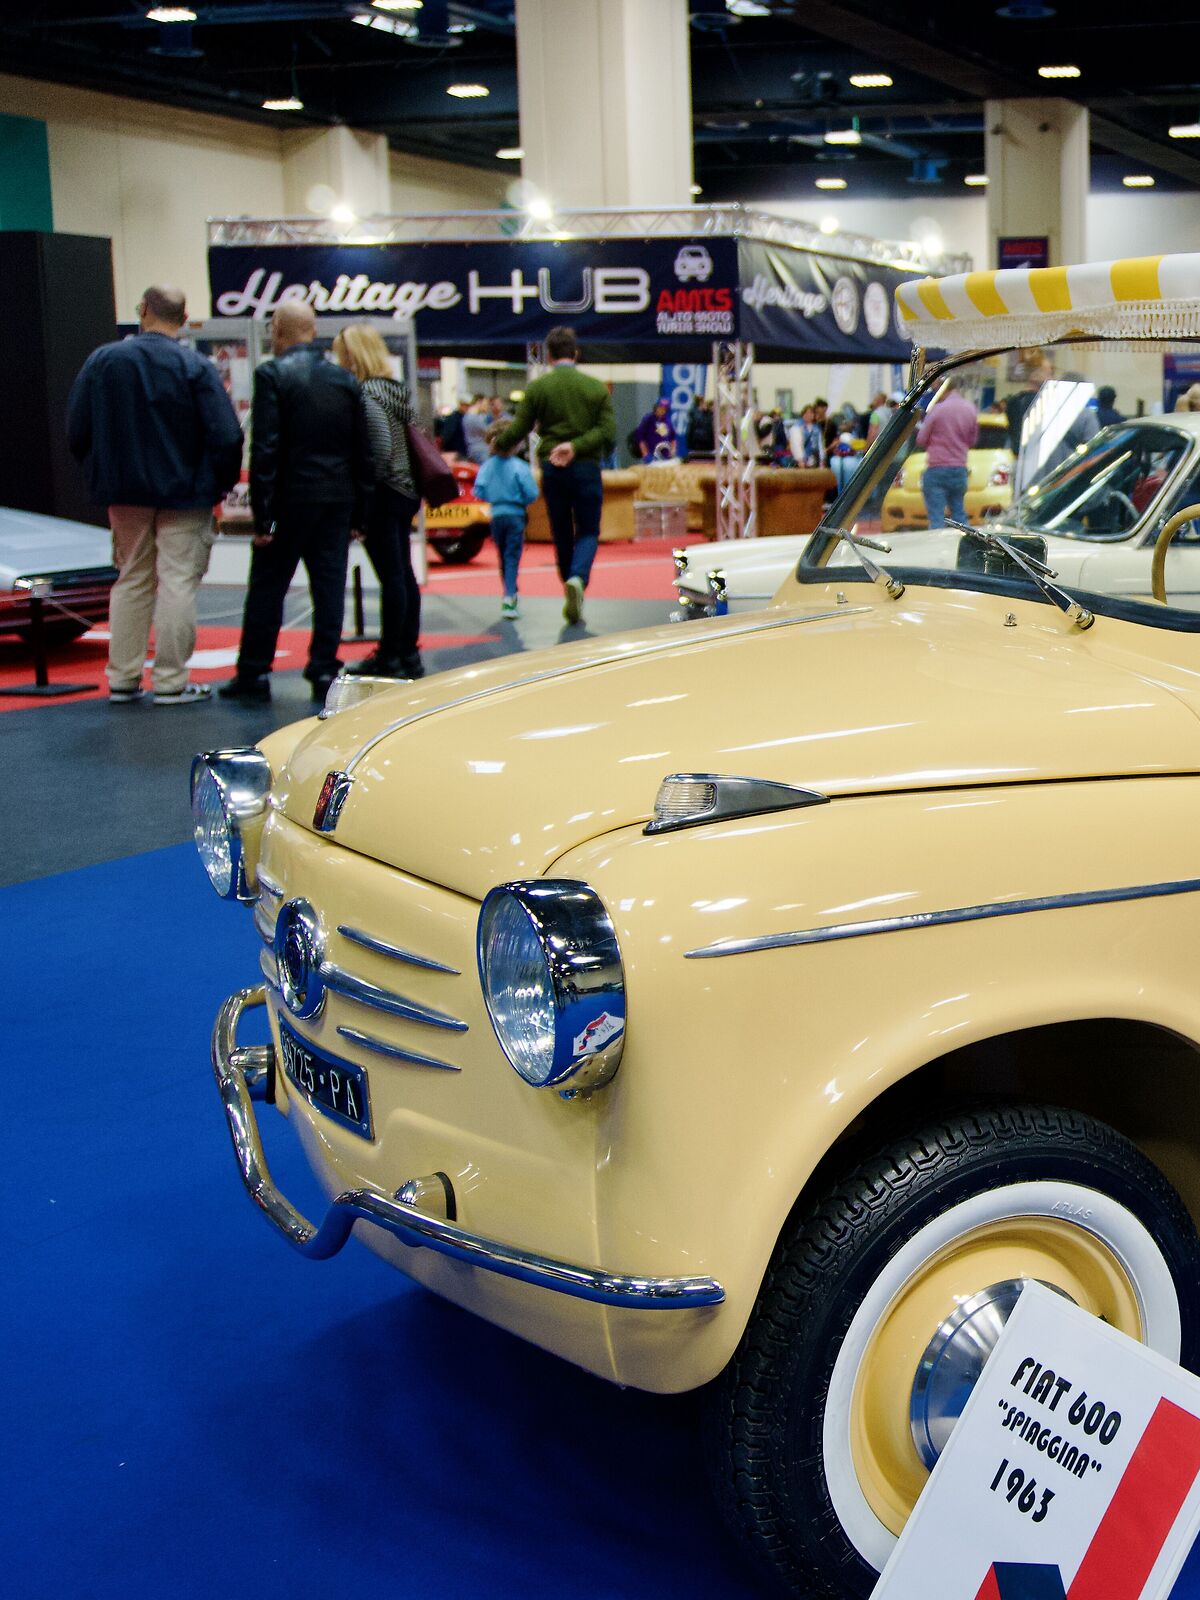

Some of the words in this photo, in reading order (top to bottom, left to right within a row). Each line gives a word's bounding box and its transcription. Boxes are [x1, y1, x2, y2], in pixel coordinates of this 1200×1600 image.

[216, 268, 462, 320] Heritage
[468, 267, 650, 314] HUB
[656, 288, 734, 312] AMTS
[424, 505, 470, 519] BARTH
[330, 1068, 358, 1119] PA
[1050, 1201, 1094, 1220] ATLAS
[1010, 1357, 1073, 1412] FIAT
[1067, 1391, 1122, 1446] 600
[998, 1399, 1102, 1479] "SPIAGGINA"
[989, 1458, 1056, 1523] 1963
